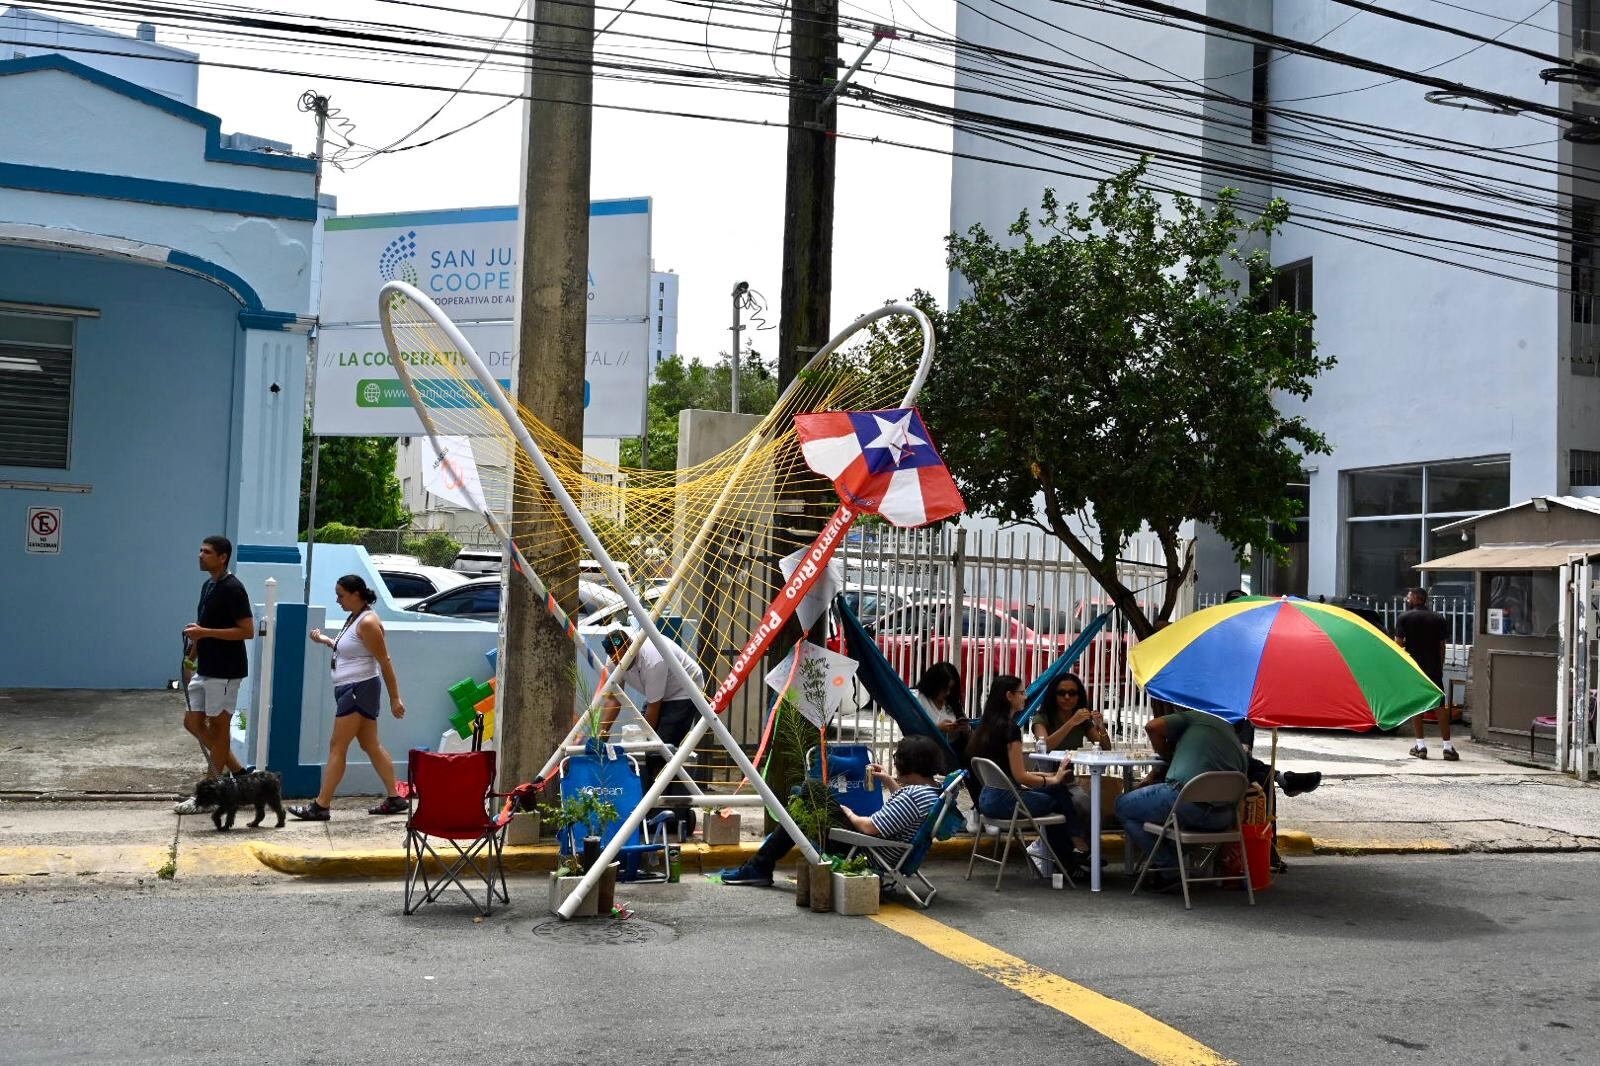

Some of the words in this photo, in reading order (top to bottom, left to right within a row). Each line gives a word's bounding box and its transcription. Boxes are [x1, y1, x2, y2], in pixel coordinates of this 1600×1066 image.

[430, 249, 475, 269] SAN
[485, 247, 517, 267] JU
[430, 271, 517, 292] COOPE
[491, 295, 504, 304] DE
[339, 351, 359, 367] LA
[488, 351, 512, 367] DE
[811, 505, 853, 562] PUERTO
[785, 558, 819, 599] RICO
[734, 610, 783, 673] PUERTO
